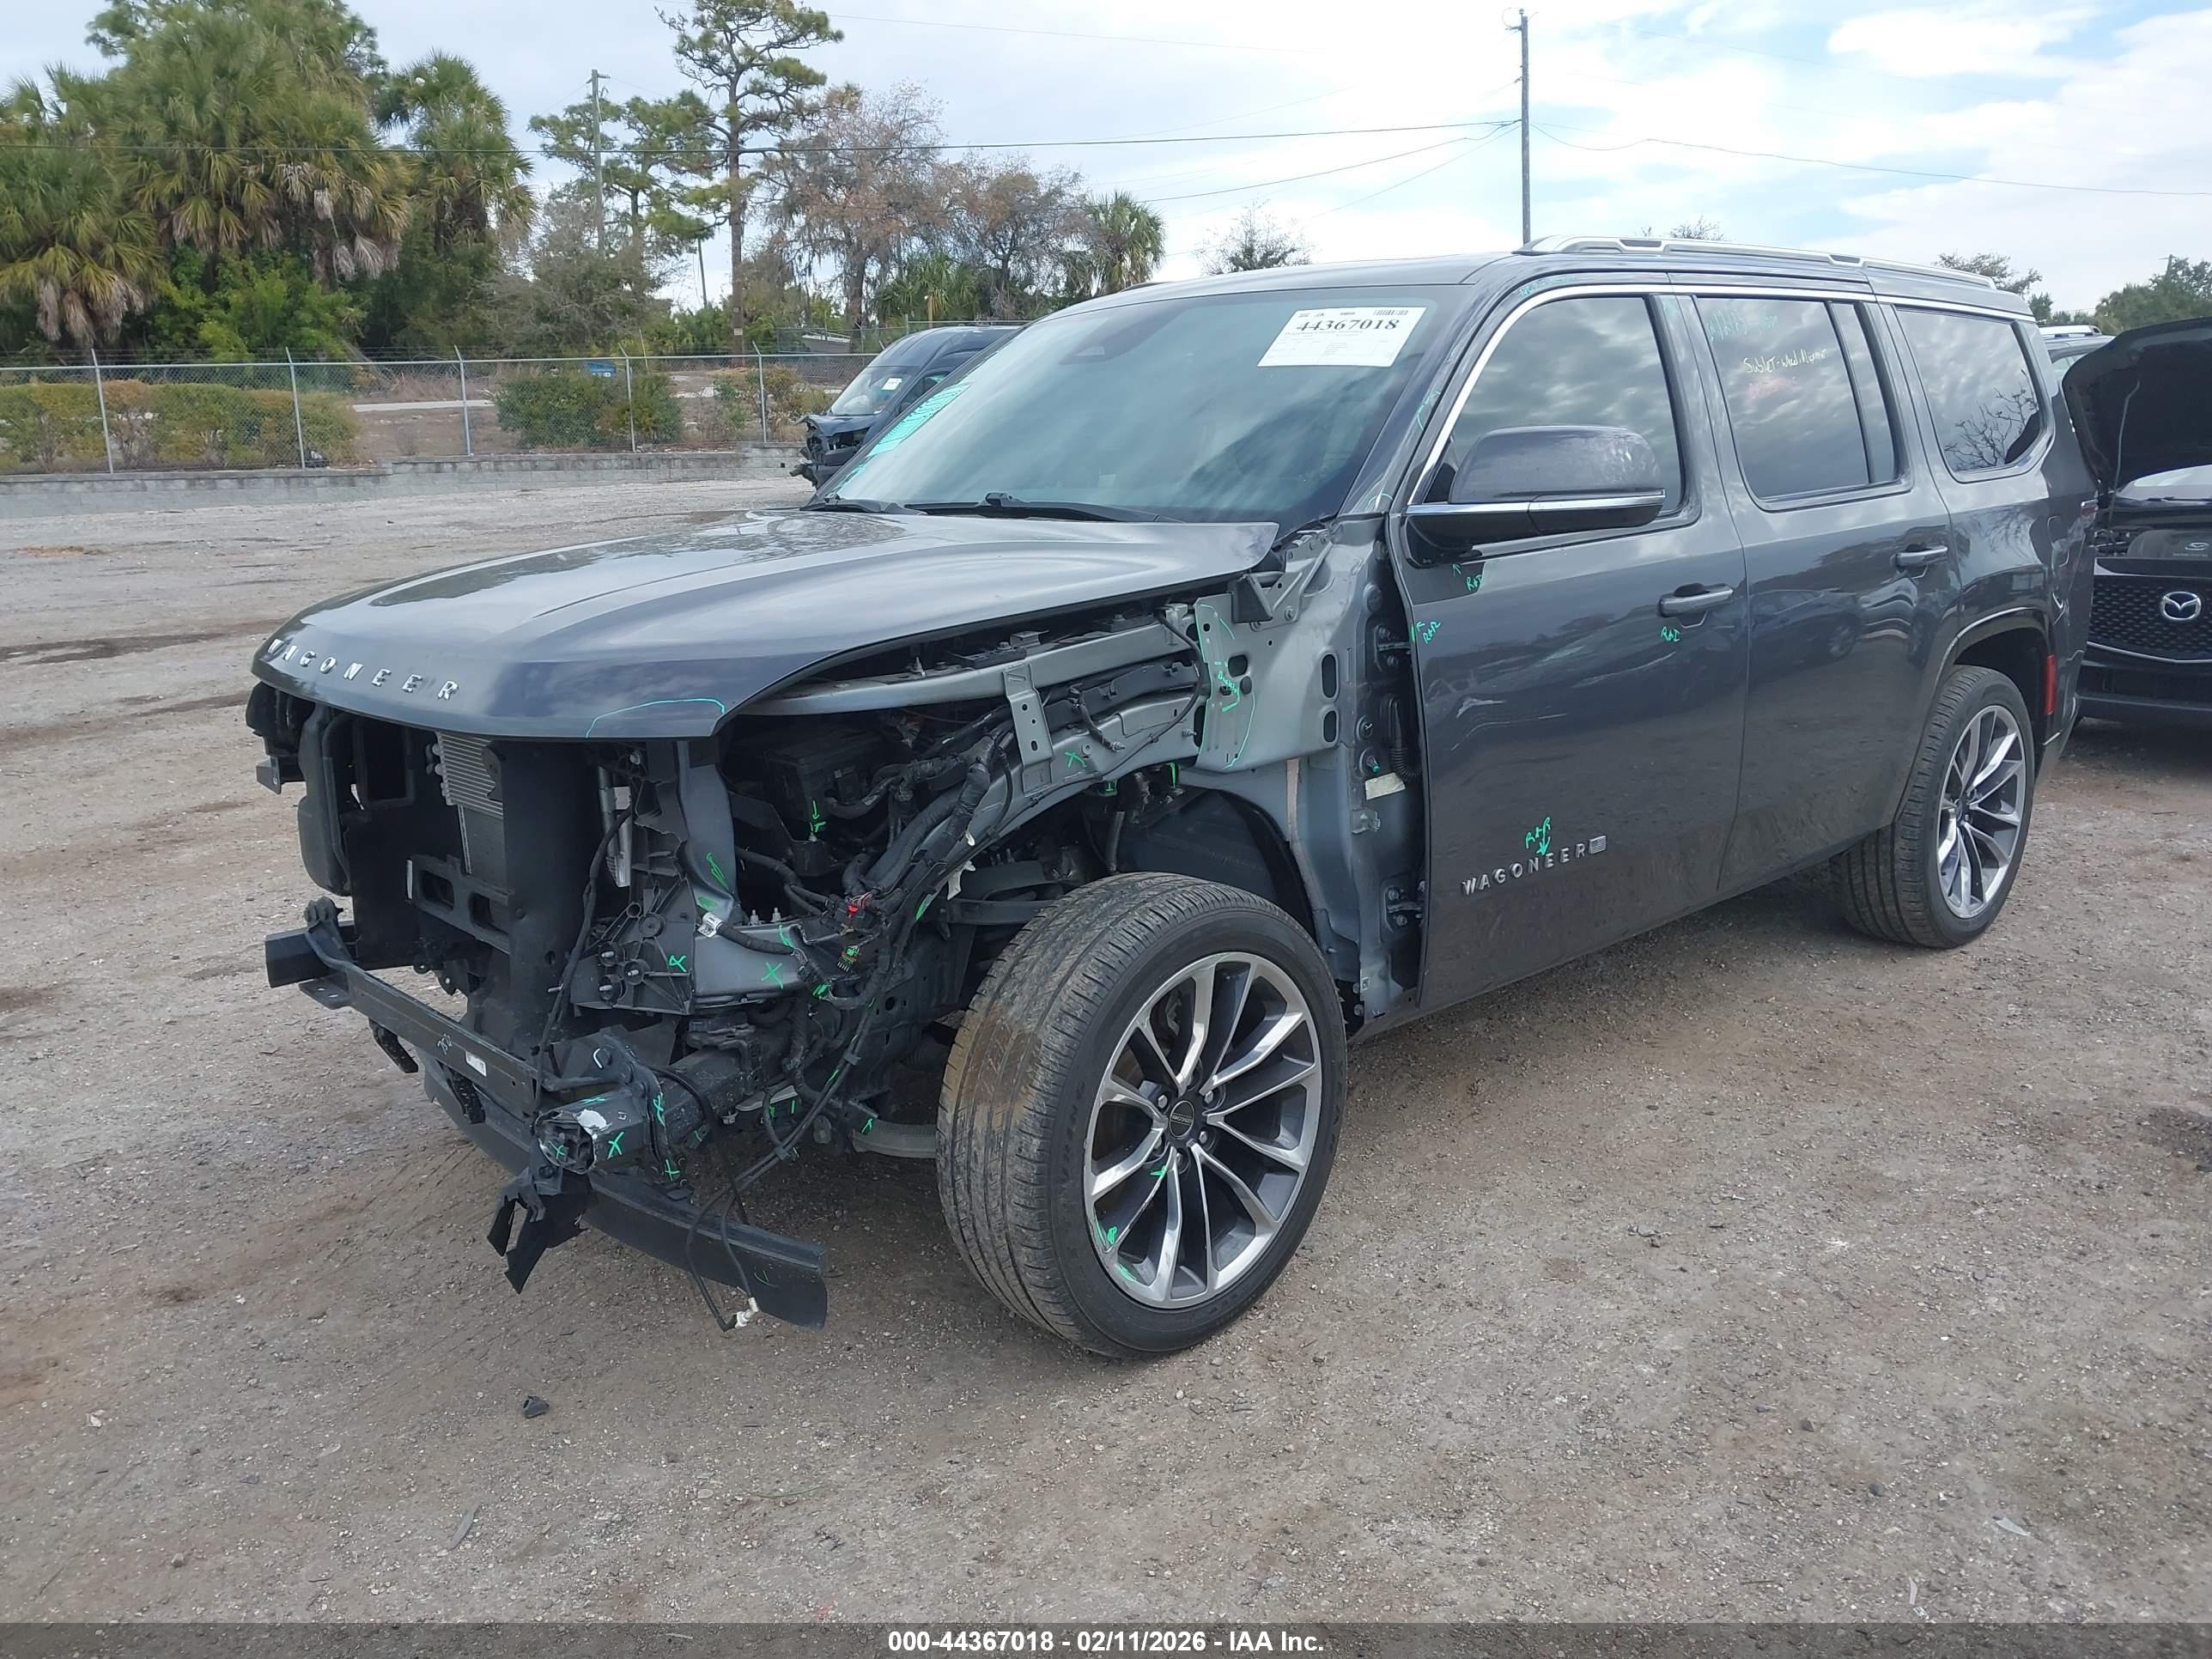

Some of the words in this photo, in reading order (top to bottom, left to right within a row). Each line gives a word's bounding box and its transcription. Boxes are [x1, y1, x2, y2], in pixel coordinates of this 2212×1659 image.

[1295, 319, 1401, 331] 44367018
[267, 638, 459, 701] WAGONEER
[1462, 843, 1586, 896] WAGONEER
